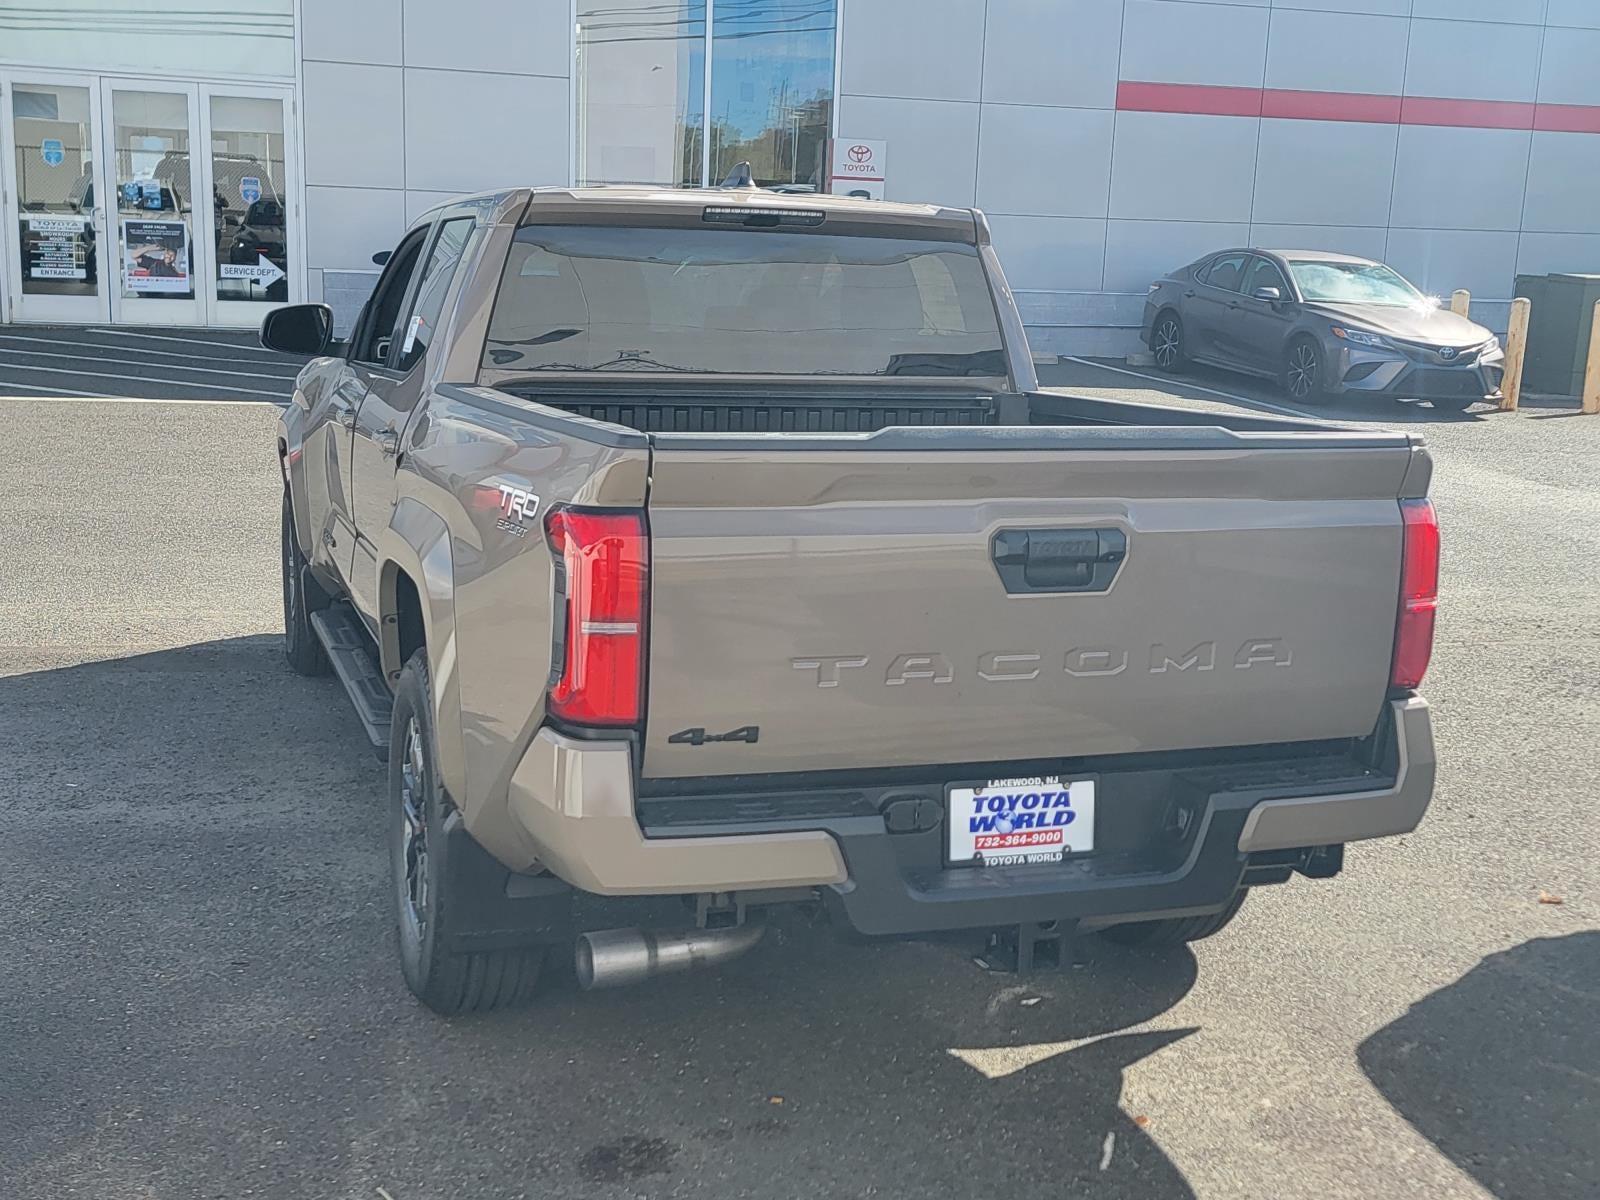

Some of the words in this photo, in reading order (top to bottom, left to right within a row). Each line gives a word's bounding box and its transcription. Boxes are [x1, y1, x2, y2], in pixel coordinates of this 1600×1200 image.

[842, 163, 876, 173] TOYOTA
[224, 267, 255, 275] SERVICE
[499, 484, 540, 522] TRD
[791, 637, 1293, 688] TACOMA
[987, 776, 1045, 788] LAKEWOOD,
[1046, 775, 1059, 784] NJ
[973, 791, 1071, 814] TOYOTA
[969, 809, 1077, 834] WORLD
[976, 831, 1061, 848] 732-364-9000
[984, 853, 1026, 867] TOYOTA
[1027, 852, 1063, 863] WORLD
